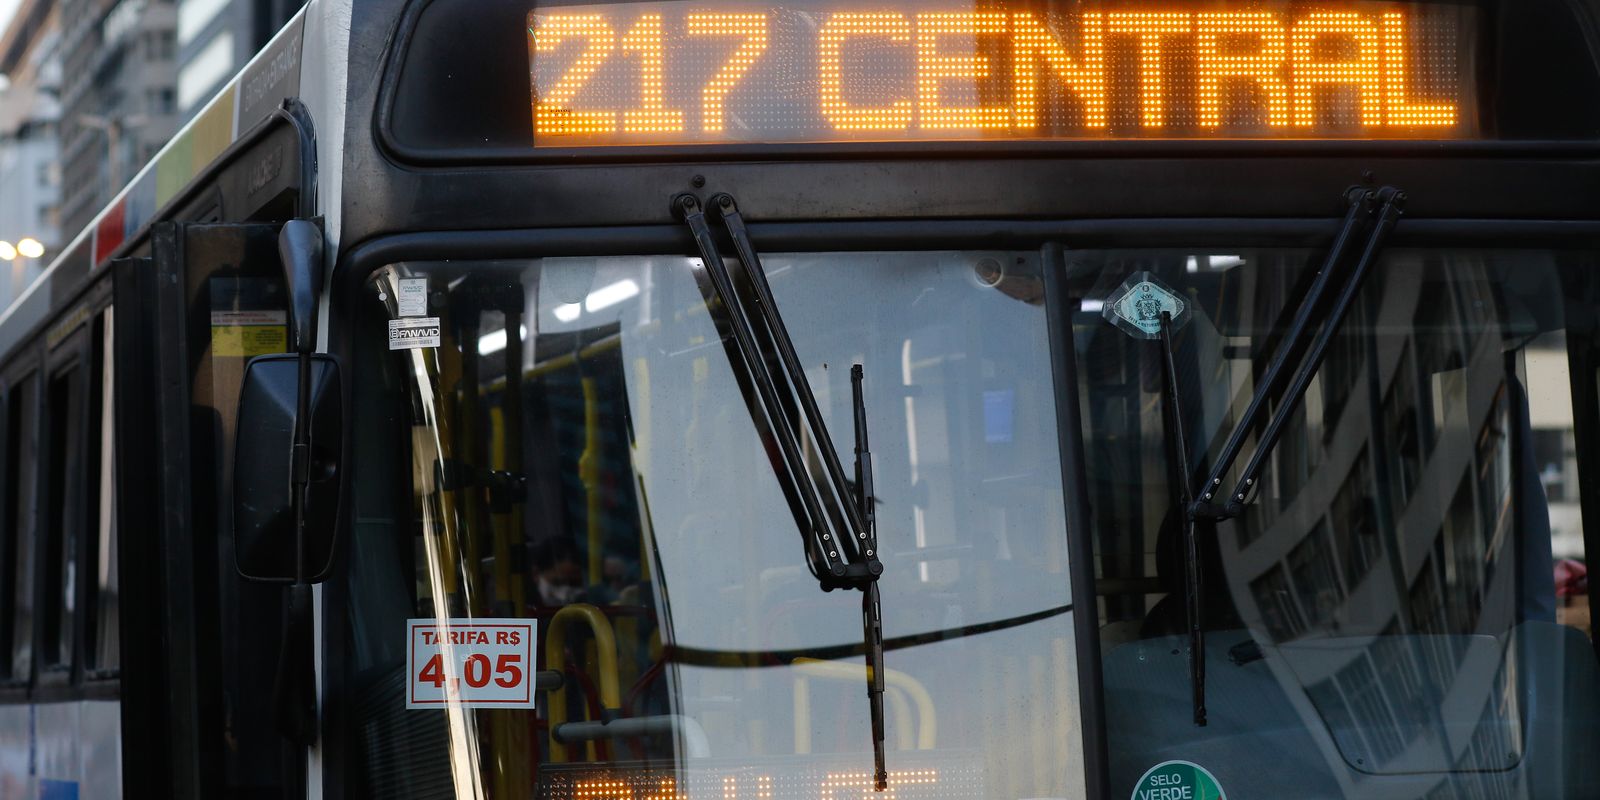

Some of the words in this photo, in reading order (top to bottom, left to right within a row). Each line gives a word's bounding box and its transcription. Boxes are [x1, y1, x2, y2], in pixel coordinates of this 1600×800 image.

[534, 13, 768, 133] 217
[819, 12, 1457, 130] CENTRAL
[400, 328, 439, 339] FANAVID
[422, 631, 490, 645] TARIFA
[496, 631, 521, 646] R$
[418, 653, 523, 692] 4,05
[1150, 773, 1182, 786] SELO
[1139, 786, 1193, 800] VERDE
